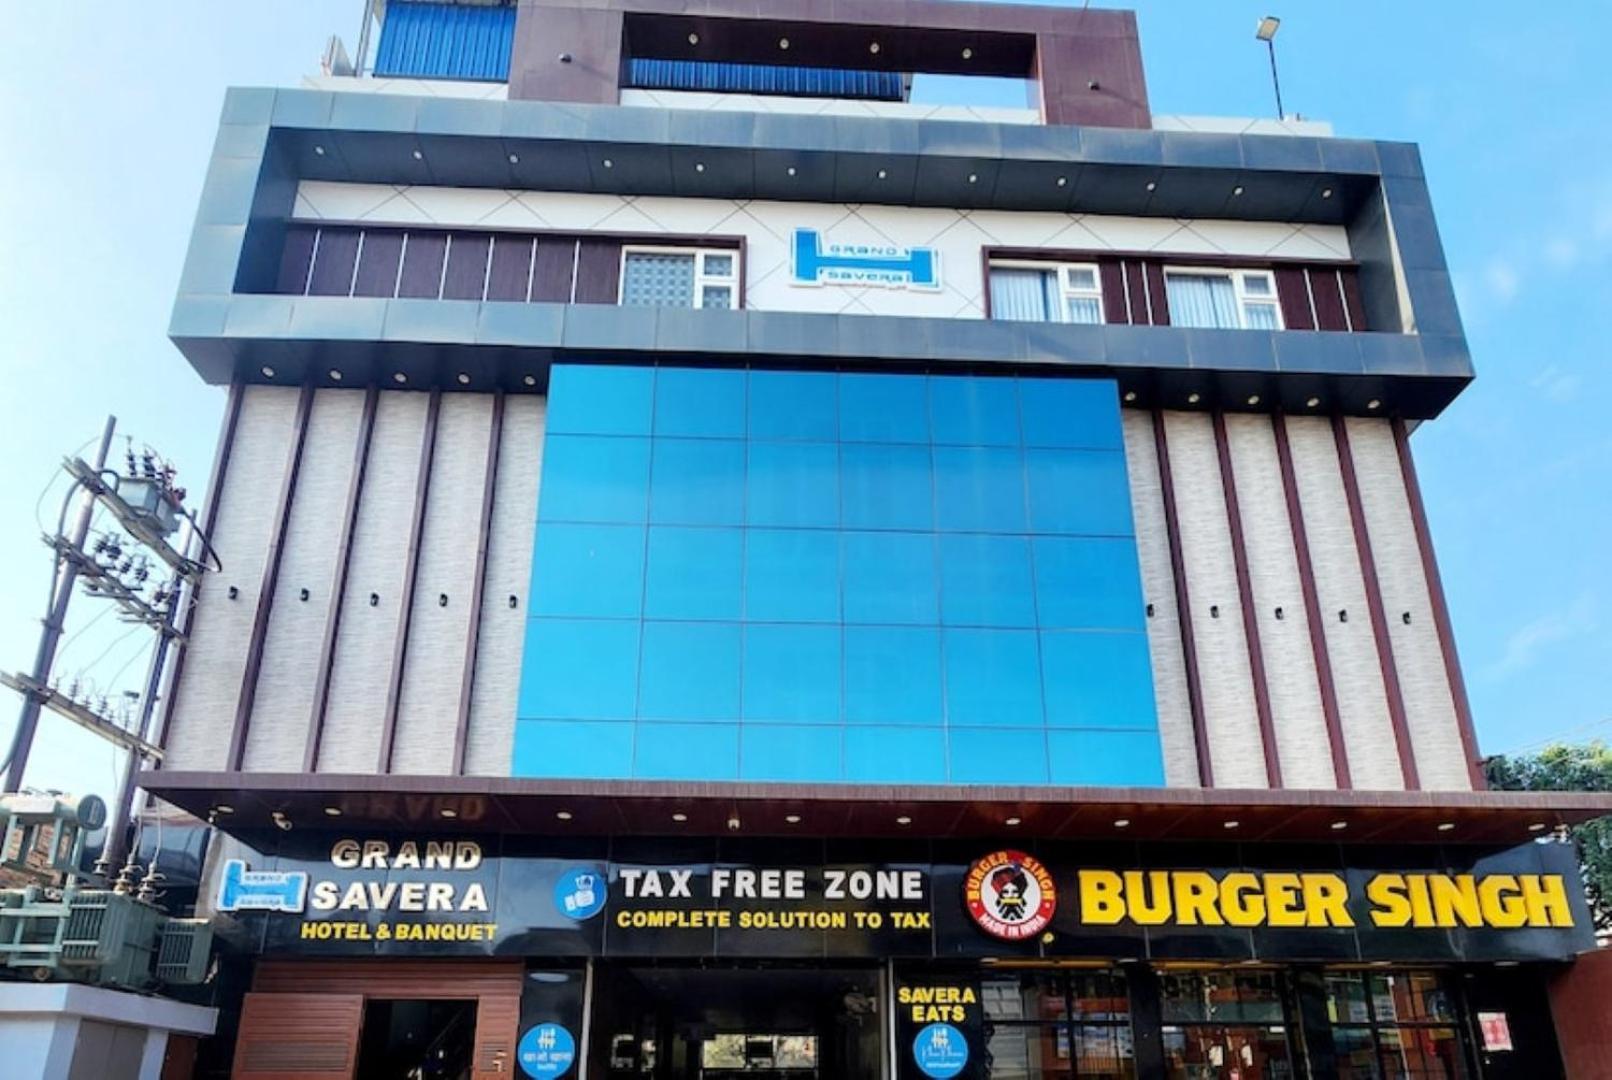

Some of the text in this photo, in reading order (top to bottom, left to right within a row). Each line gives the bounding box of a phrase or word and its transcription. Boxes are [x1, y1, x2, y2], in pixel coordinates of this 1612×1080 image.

[331, 839, 482, 870] GRAND
[311, 880, 488, 912] SAVERA
[620, 869, 923, 900] TAX FREE ZONE
[1079, 870, 1574, 929] BURGER SINGH
[301, 922, 498, 941] HOTEL & BANQUET
[617, 910, 931, 930] COMPLETE SOLUTION TO TAX
[898, 986, 977, 1005] SAVERA
[911, 1005, 966, 1022] EATS
